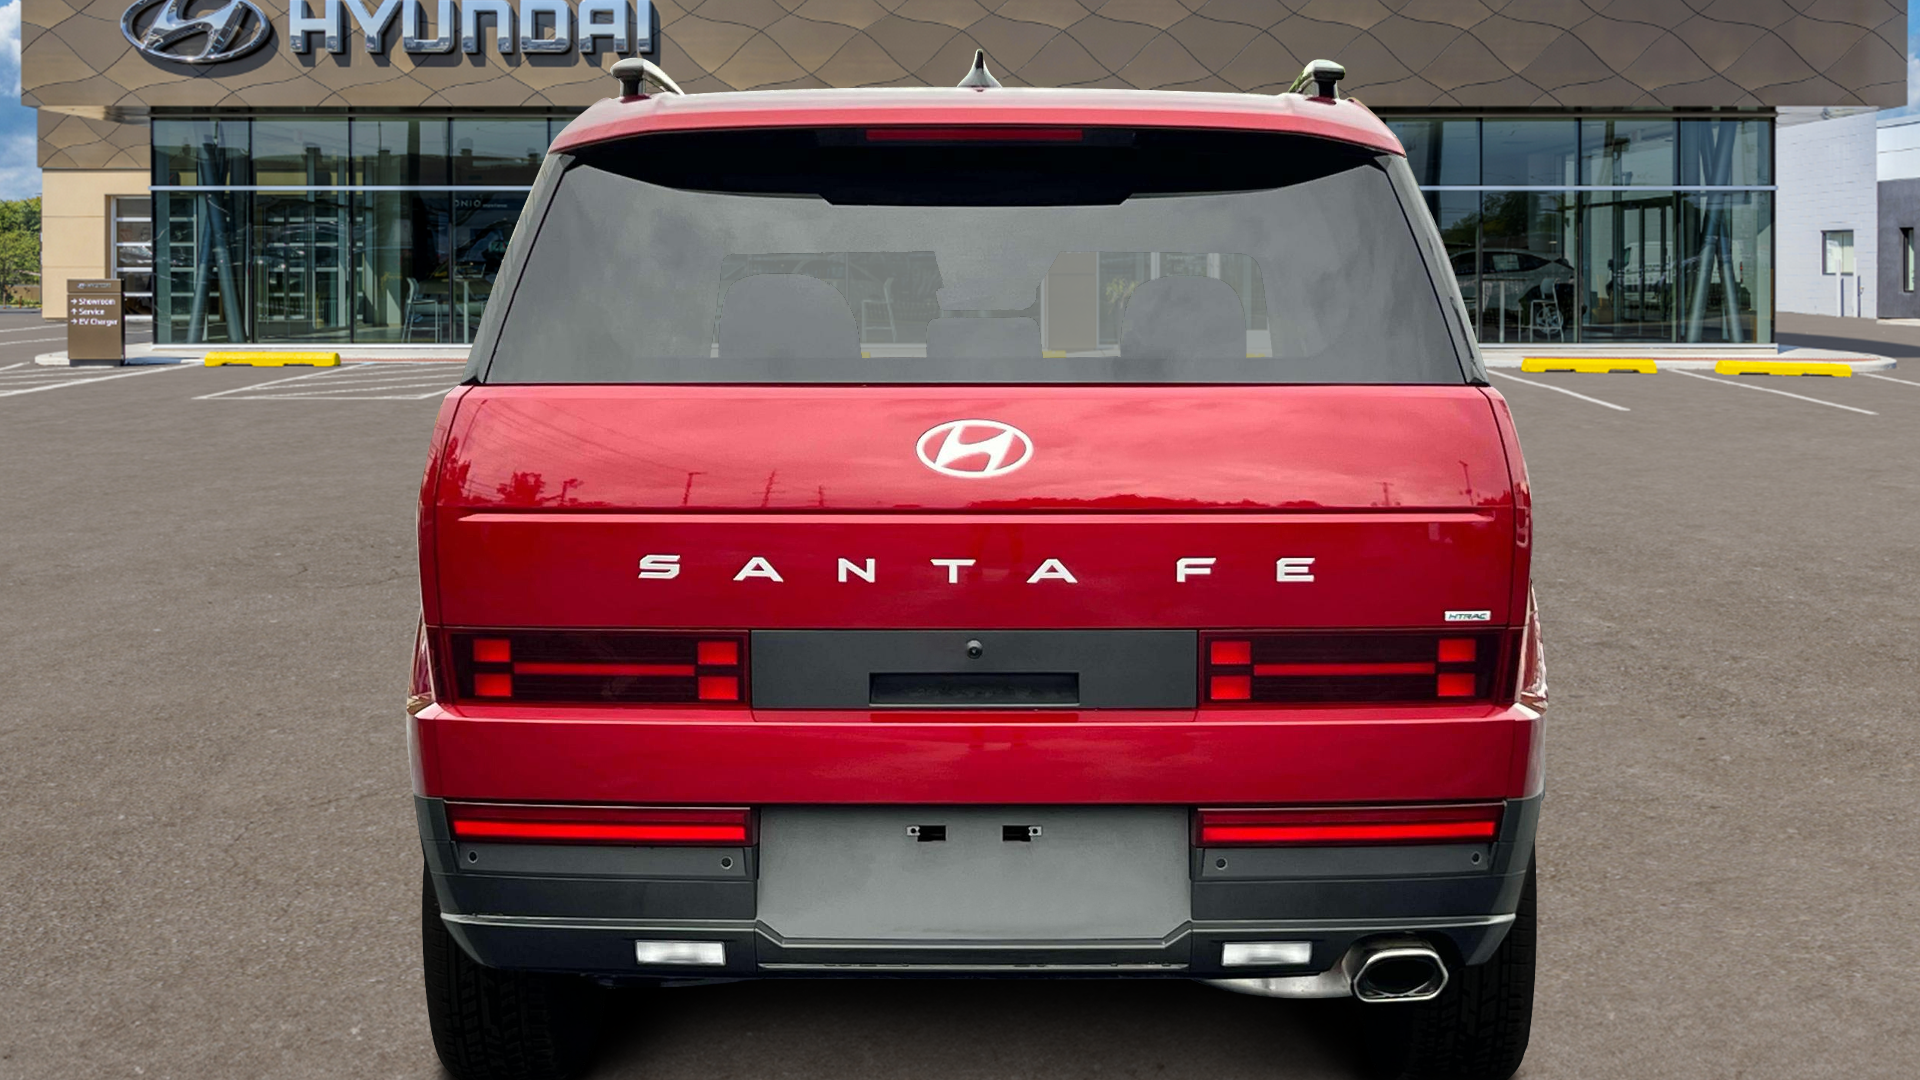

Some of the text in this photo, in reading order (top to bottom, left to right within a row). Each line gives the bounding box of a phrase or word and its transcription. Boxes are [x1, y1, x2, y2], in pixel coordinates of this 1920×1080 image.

[289, 0, 655, 53] HYUNDAI
[78, 297, 116, 306] Showroom
[78, 307, 105, 316] Service
[90, 318, 118, 327] Charger
[637, 554, 1316, 584] SANTA FE
[1448, 612, 1488, 620] HTRAC
